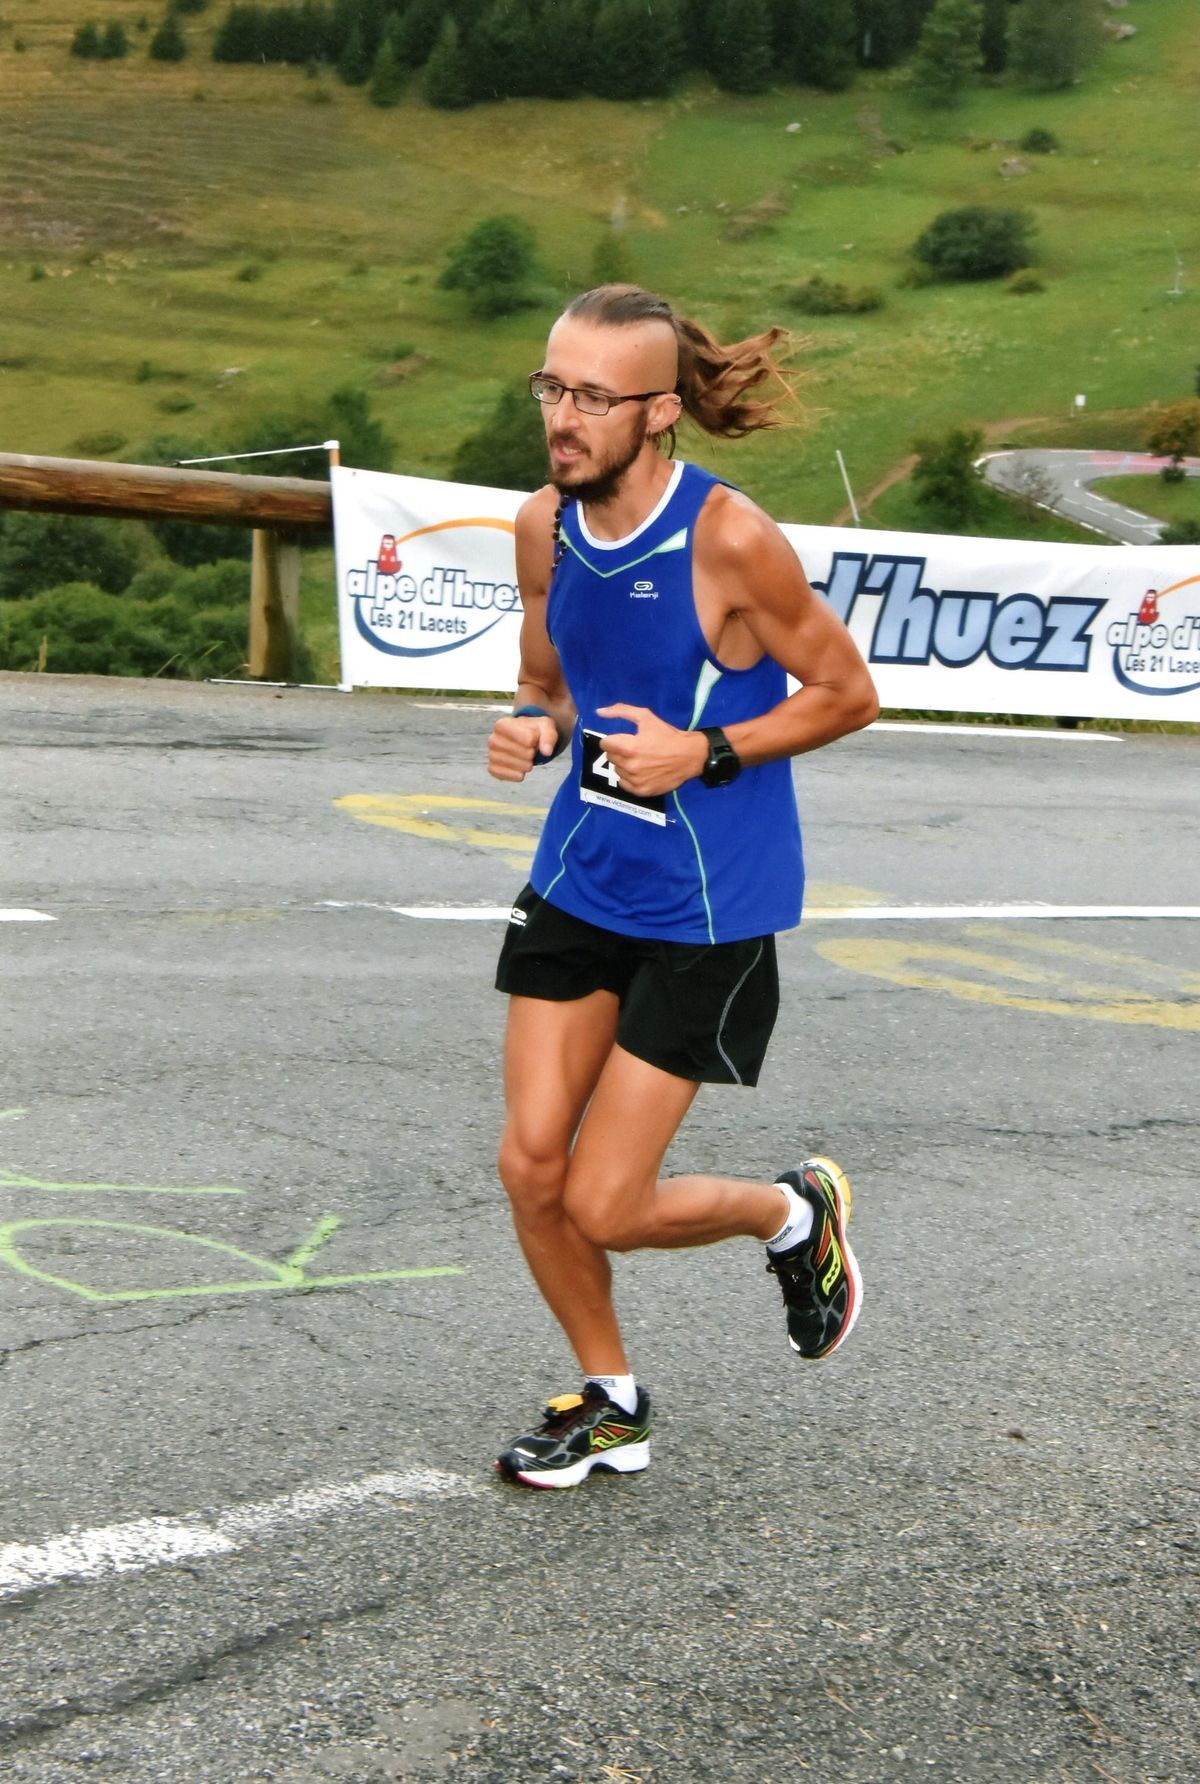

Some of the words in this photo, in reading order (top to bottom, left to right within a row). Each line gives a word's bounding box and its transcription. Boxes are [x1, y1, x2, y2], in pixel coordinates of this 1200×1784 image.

[346, 559, 417, 612] alpe
[370, 608, 392, 628] Les
[398, 610, 414, 630] 21
[420, 611, 467, 634] Lacets
[1106, 612, 1168, 656] alpe
[1125, 654, 1145, 672] Les
[1151, 655, 1163, 673] 21
[592, 751, 621, 788] 4
